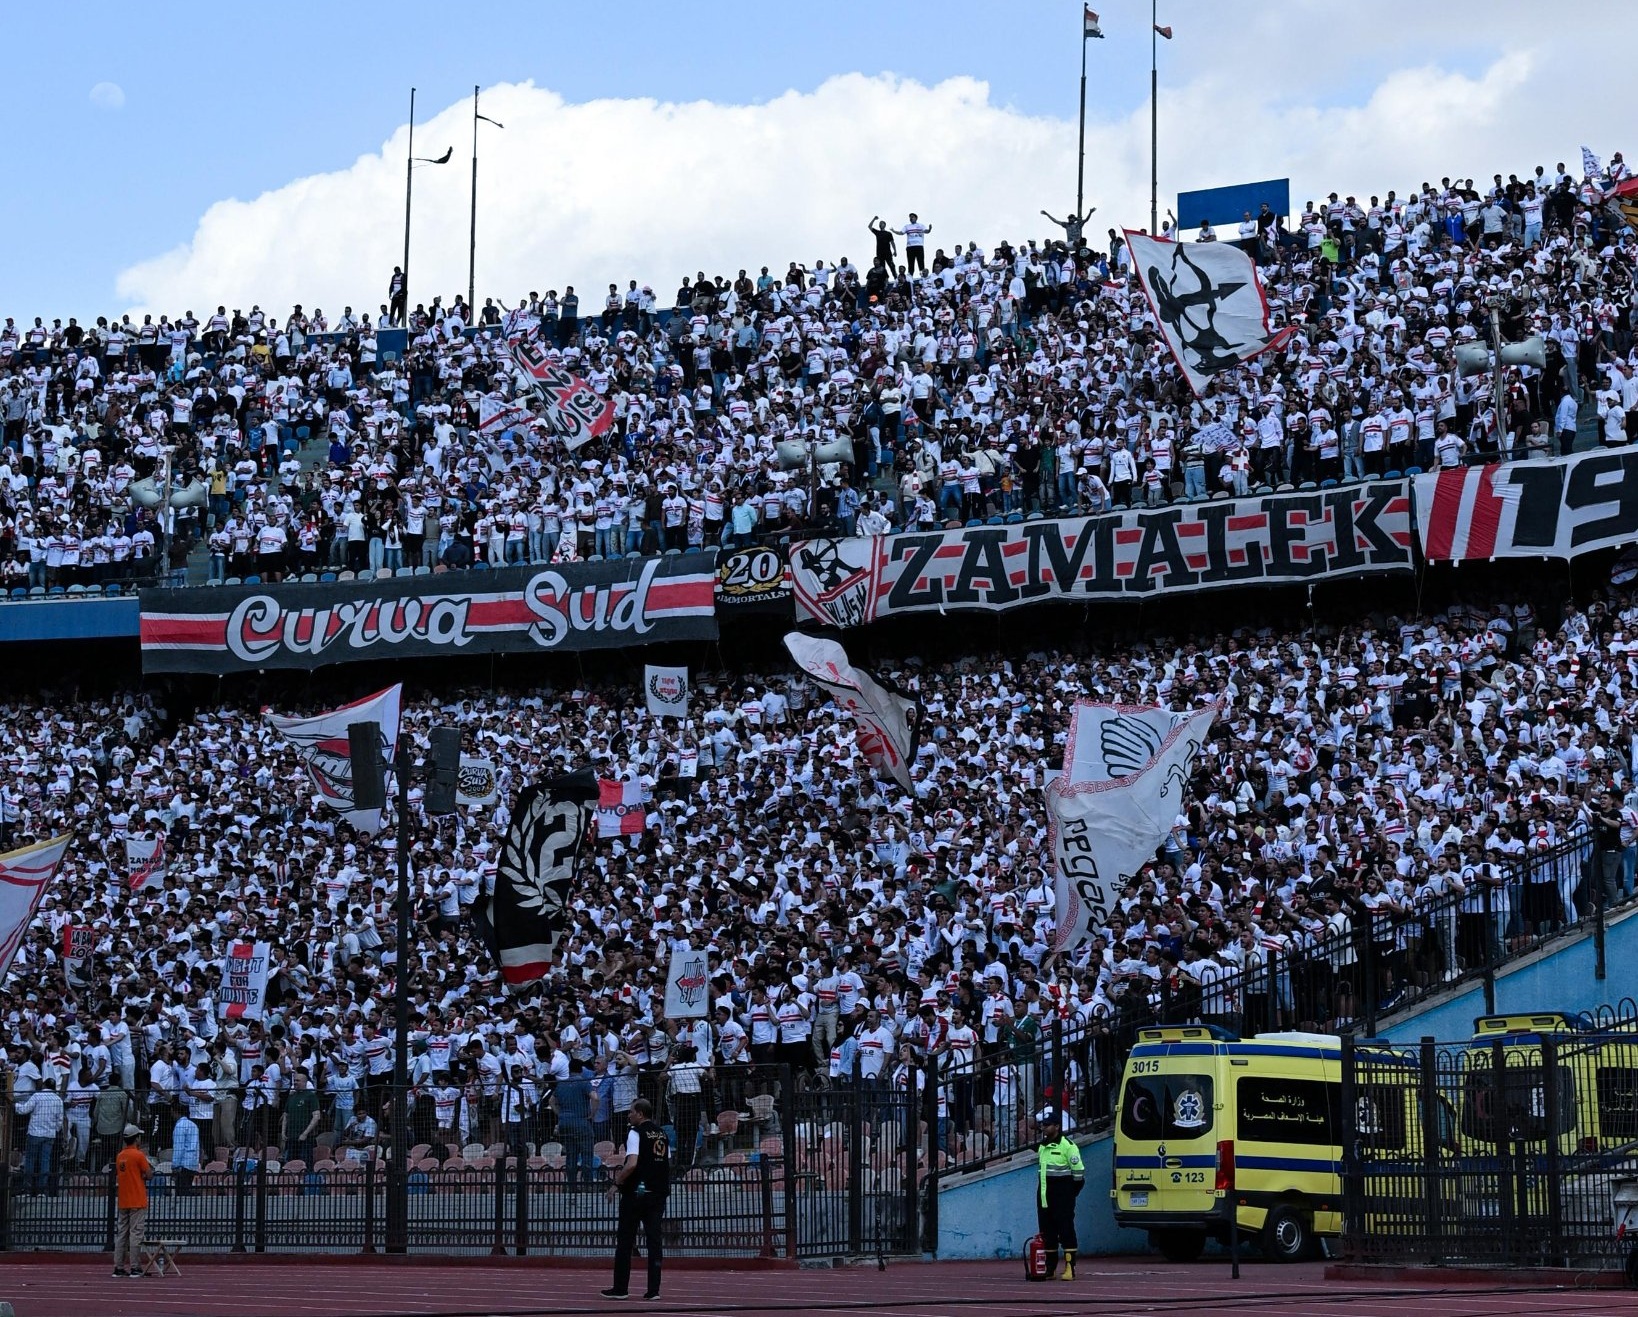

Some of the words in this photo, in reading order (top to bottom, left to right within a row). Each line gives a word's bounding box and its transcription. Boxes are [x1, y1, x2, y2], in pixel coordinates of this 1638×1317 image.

[1508, 452, 1638, 548] 19
[889, 483, 1412, 608] ZAMALEK
[726, 551, 779, 585] 20
[719, 590, 787, 605] IMMORTALS
[225, 591, 474, 662] Curva
[524, 557, 662, 647] Sud
[458, 766, 490, 780] CURVA
[460, 777, 488, 788] SUD
[599, 803, 643, 817] UTOPIA
[229, 976, 249, 987] FOR
[220, 986, 259, 1005] WHITE
[1131, 1060, 1160, 1074] 3015
[1260, 1092, 1287, 1103] الصحة
[1287, 1095, 1305, 1107] وزارة
[1184, 1172, 1205, 1183] 123
